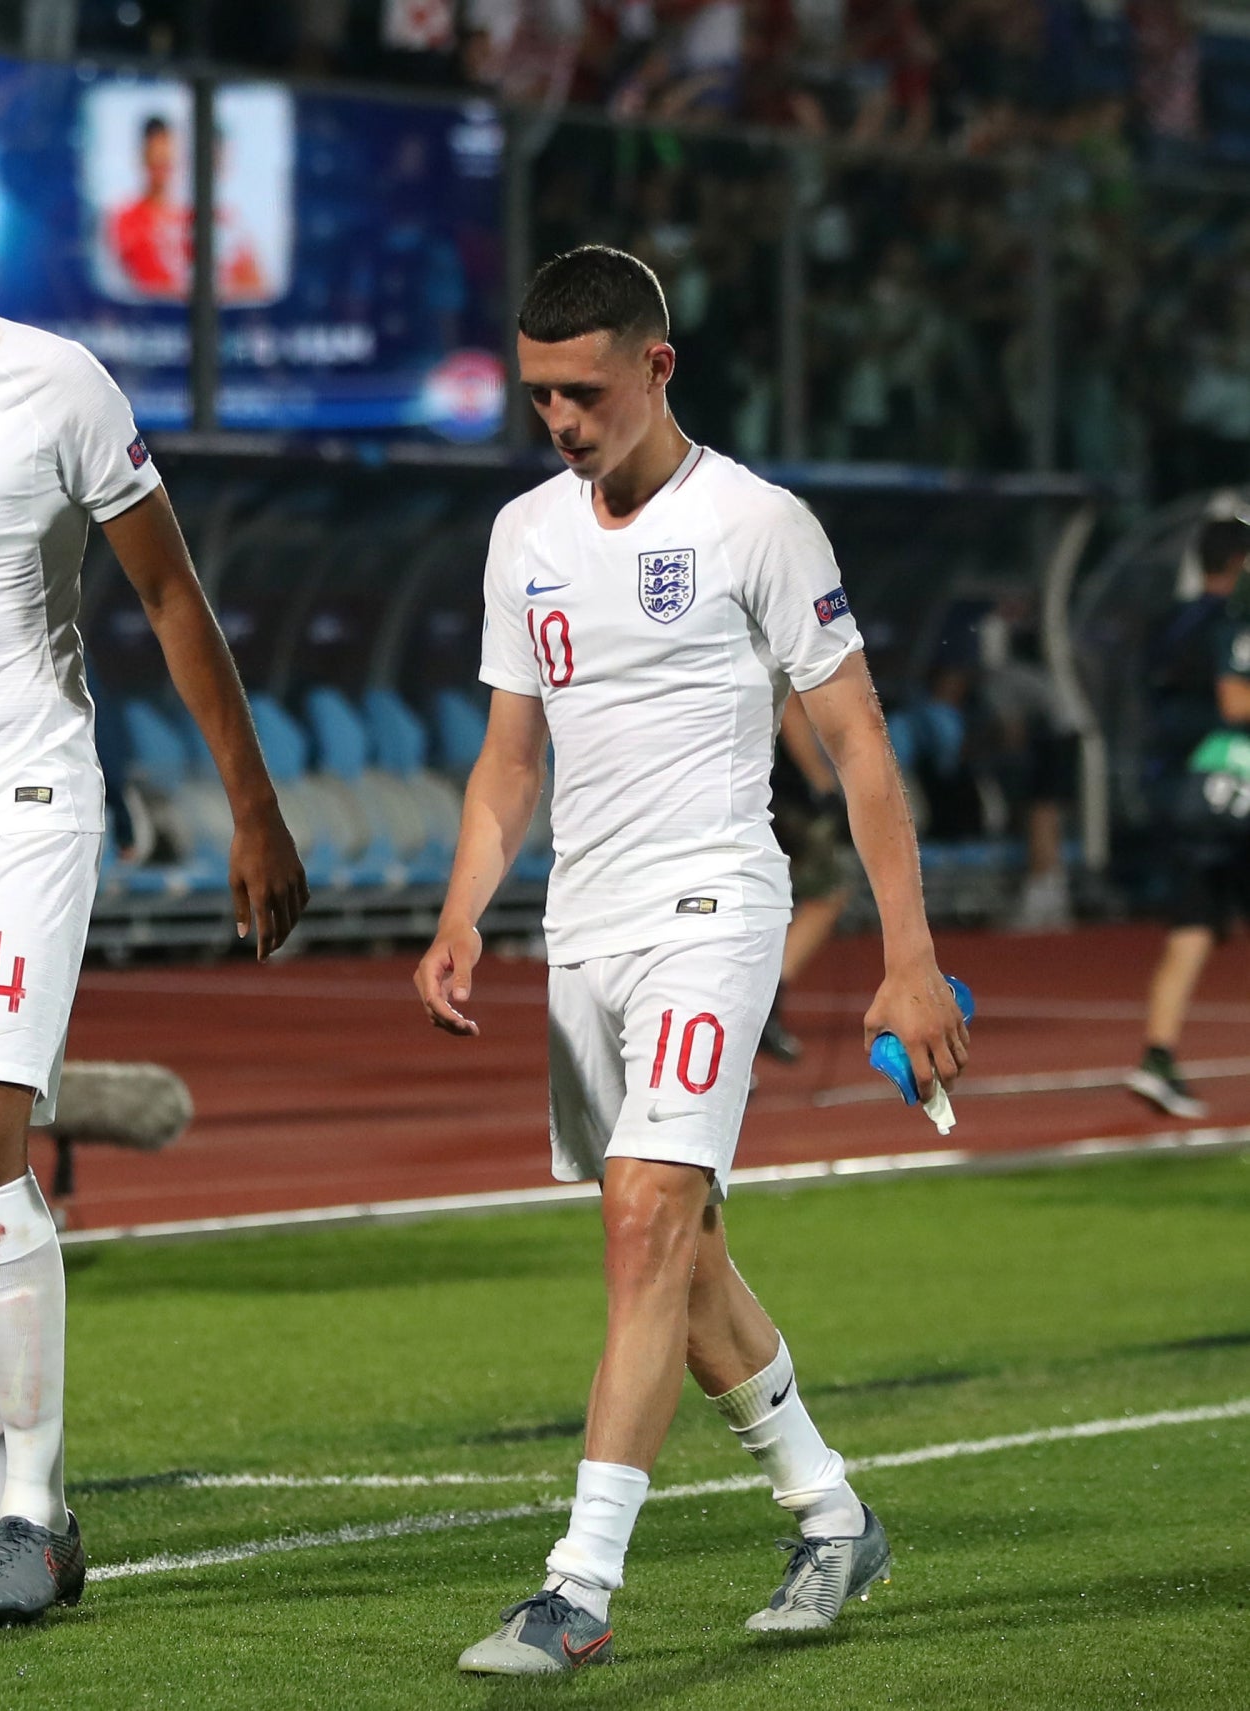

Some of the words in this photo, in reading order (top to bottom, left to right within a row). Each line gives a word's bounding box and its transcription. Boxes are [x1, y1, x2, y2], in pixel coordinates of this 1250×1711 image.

[829, 592, 848, 612] RES
[526, 607, 574, 689] 10
[649, 1008, 725, 1094] 10
